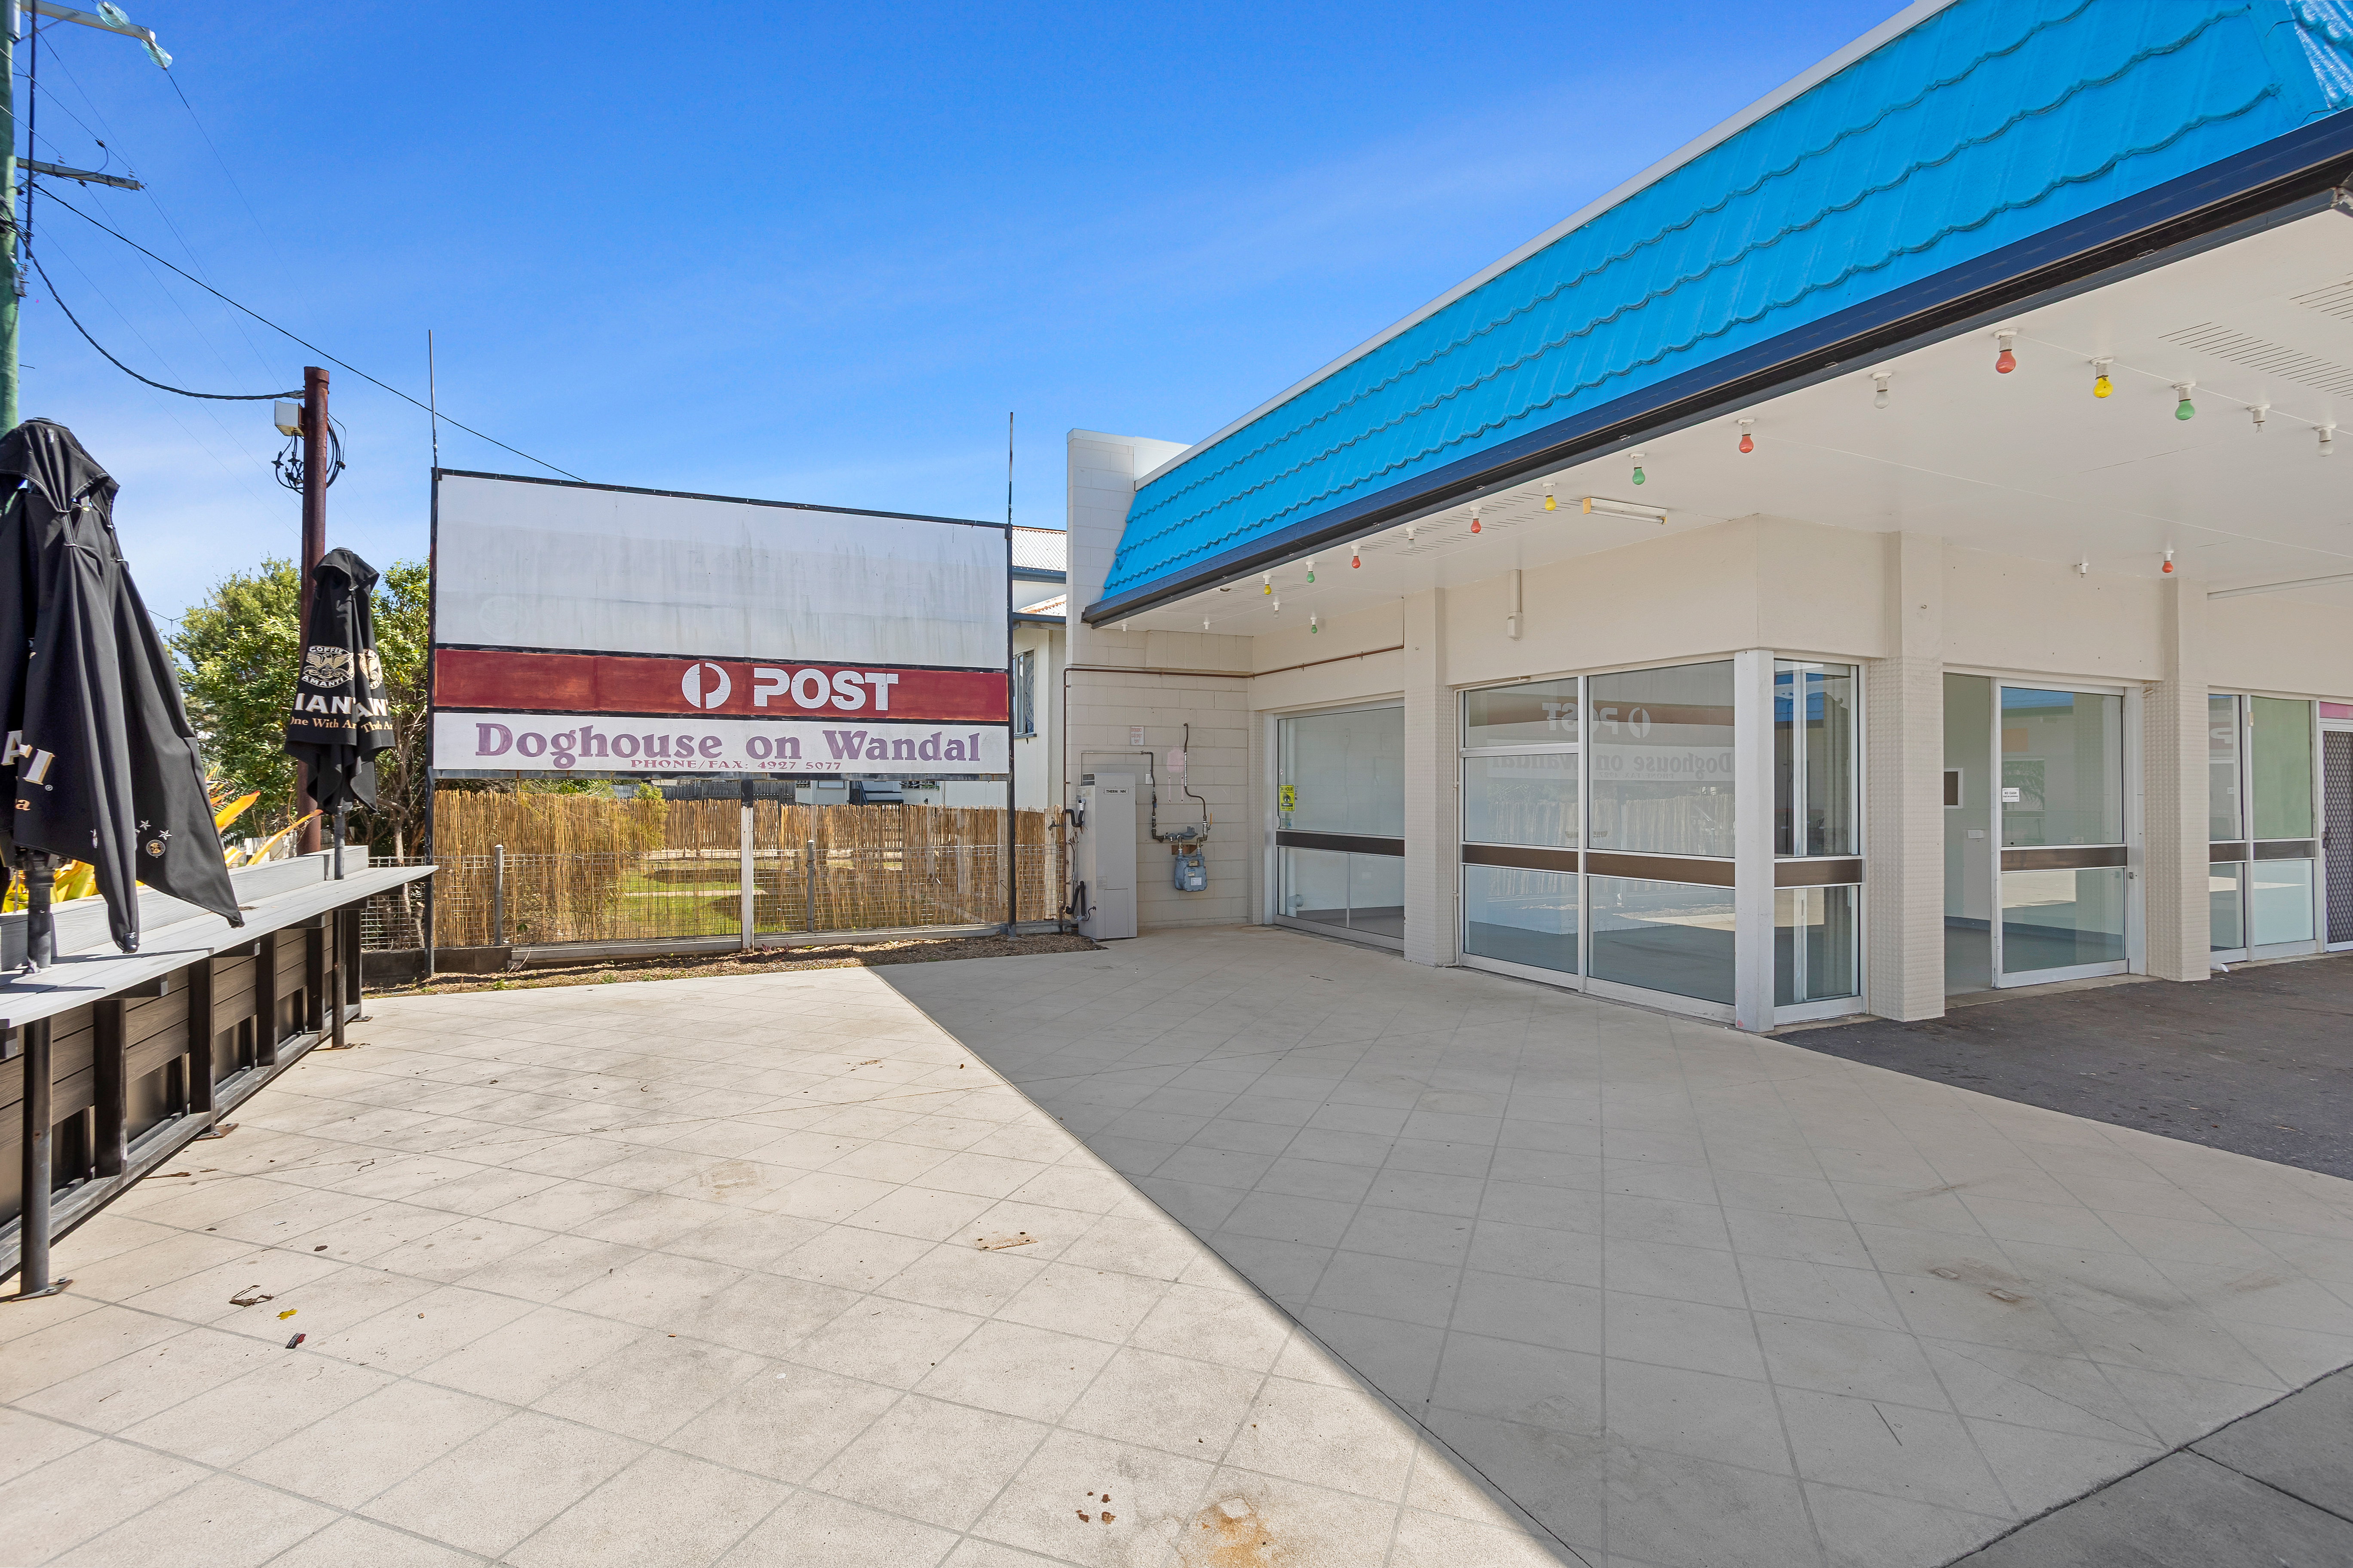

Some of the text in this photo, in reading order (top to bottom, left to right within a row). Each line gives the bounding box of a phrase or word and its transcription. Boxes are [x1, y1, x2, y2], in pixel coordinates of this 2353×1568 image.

[309, 646, 344, 655] COFFEE
[301, 675, 344, 687] AMANTI
[754, 668, 899, 710] POST
[312, 718, 339, 728] With
[475, 723, 980, 769] Doghouse on Wandal
[631, 760, 841, 770] PHONE/FAX: 4927 5077
